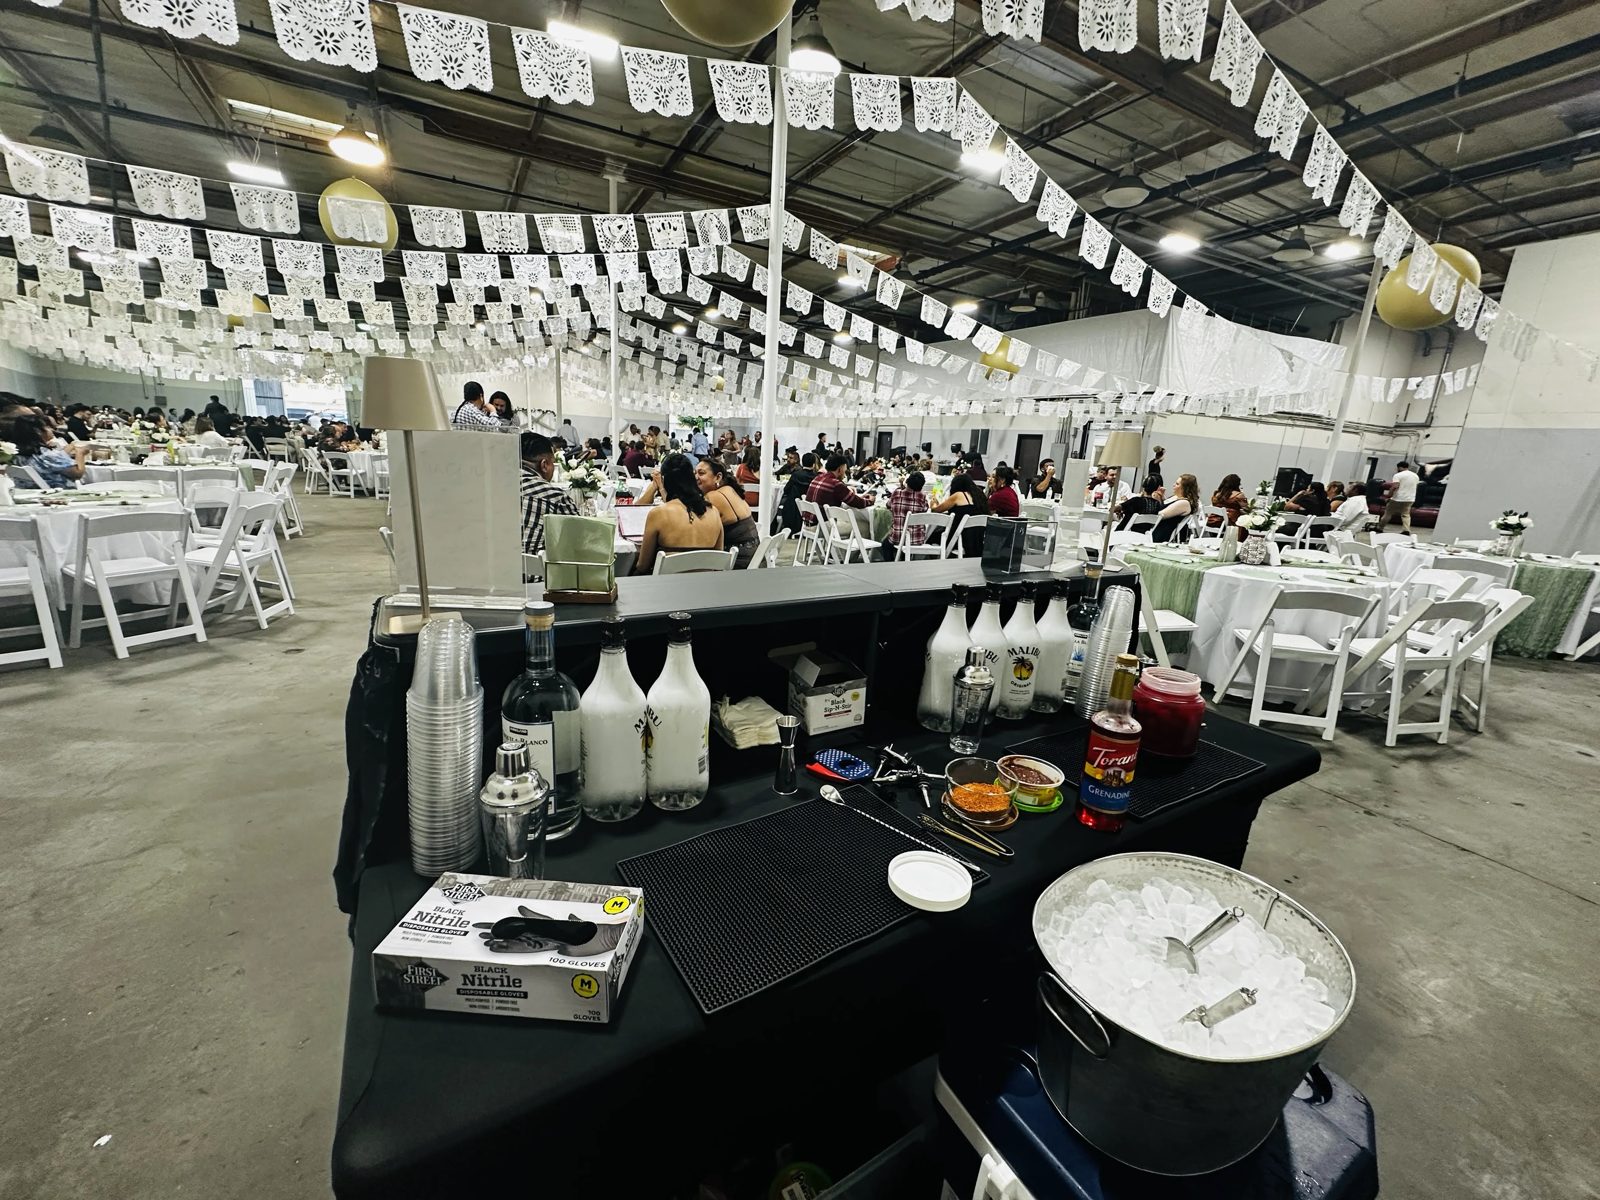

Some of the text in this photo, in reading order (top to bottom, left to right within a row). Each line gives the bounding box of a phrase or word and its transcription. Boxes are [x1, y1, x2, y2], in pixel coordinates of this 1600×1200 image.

[453, 883, 483, 892] FIRST
[444, 890, 482, 902] STREET
[611, 900, 624, 908] M
[433, 906, 466, 916] BLACK
[411, 911, 470, 928] Nitrile
[402, 923, 441, 933] DISPOSABLE
[549, 956, 607, 968] 100 GLOVES
[407, 964, 436, 977] FIRST
[474, 965, 508, 975] BLACK
[403, 974, 443, 985] STREET
[460, 974, 522, 988] Nitrile
[580, 979, 592, 990] M
